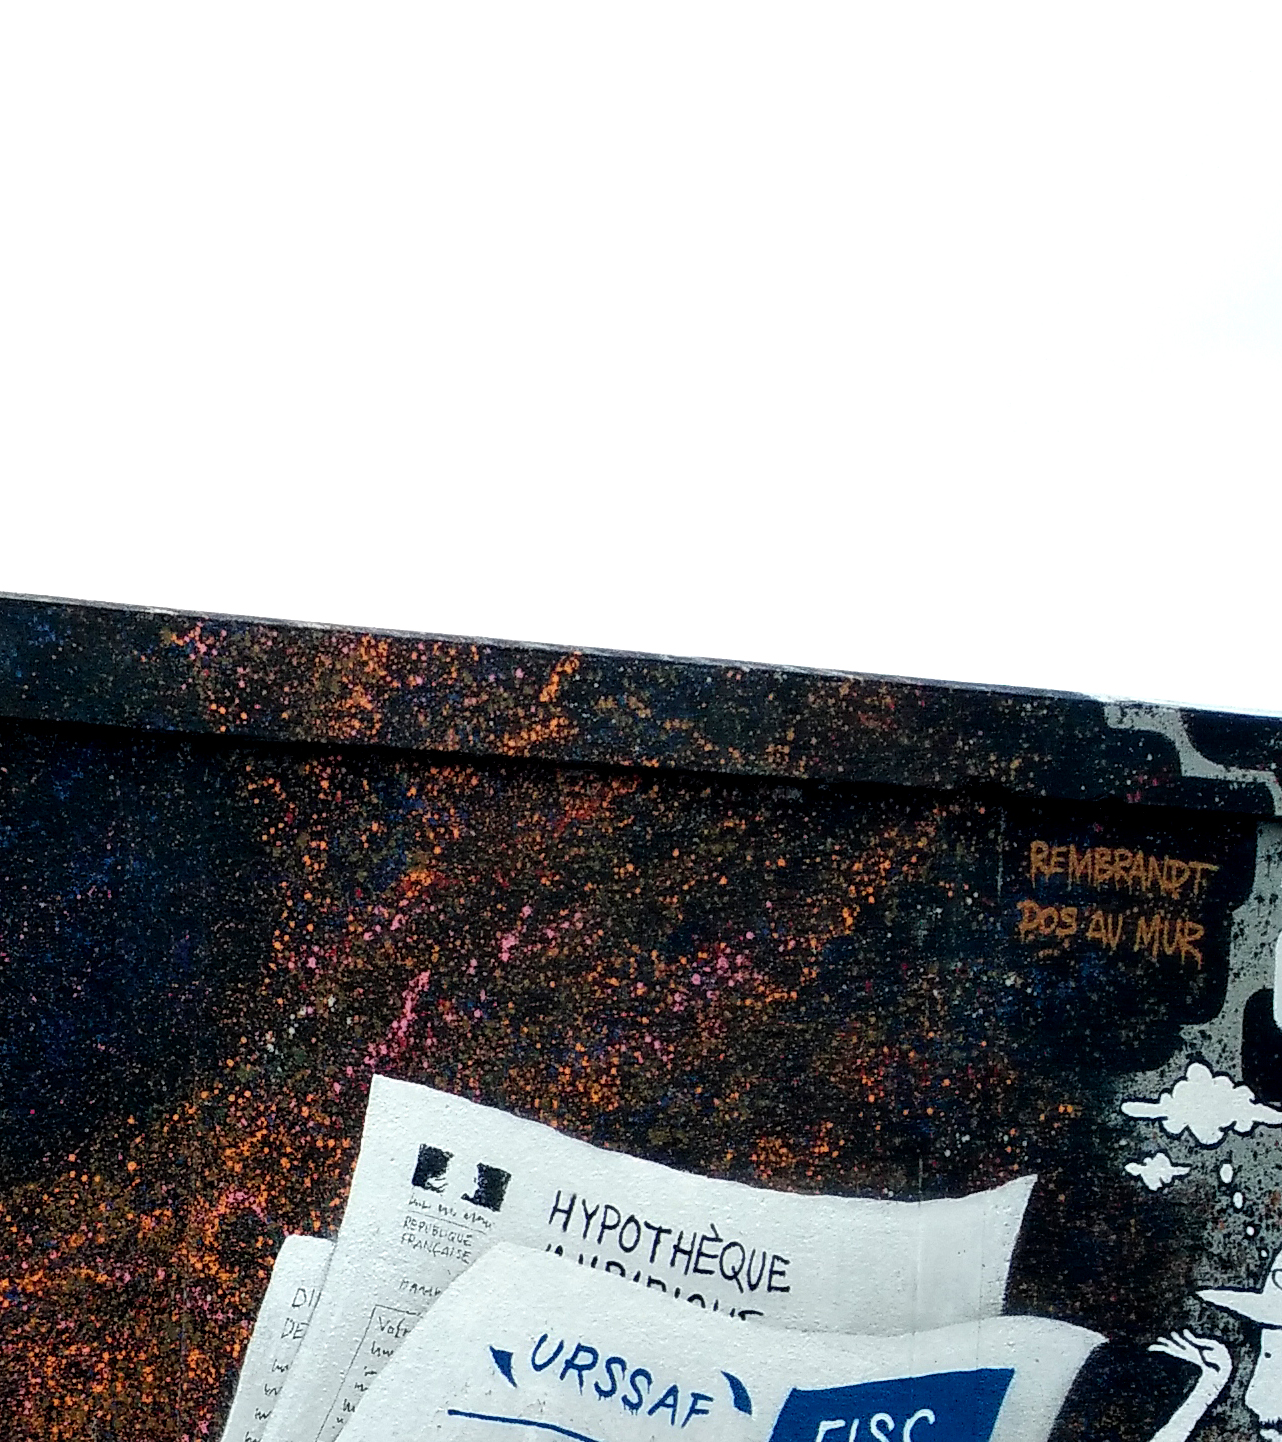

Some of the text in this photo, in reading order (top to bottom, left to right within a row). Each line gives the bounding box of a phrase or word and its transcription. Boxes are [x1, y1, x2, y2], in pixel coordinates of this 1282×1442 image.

[1029, 840, 1219, 896] REMBRANDT
[1134, 912, 1205, 968] MUR
[549, 1190, 791, 1294] HYPOTHÈQUE
[531, 1333, 714, 1429] URSSAF
